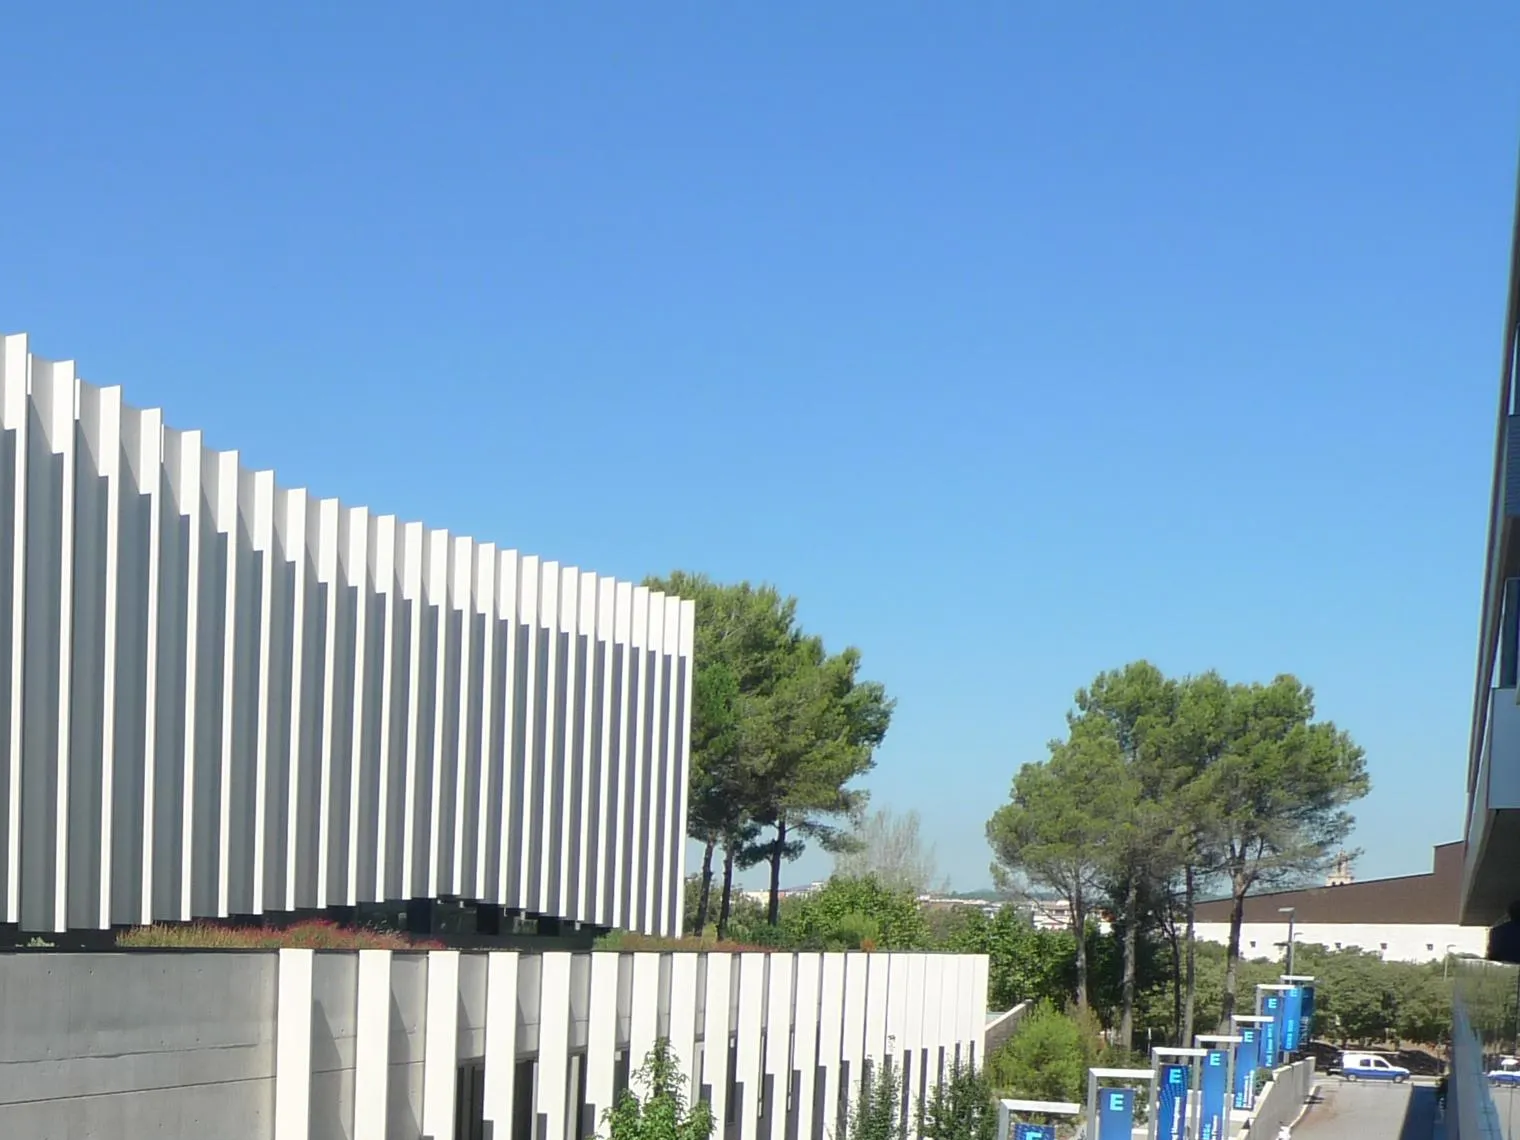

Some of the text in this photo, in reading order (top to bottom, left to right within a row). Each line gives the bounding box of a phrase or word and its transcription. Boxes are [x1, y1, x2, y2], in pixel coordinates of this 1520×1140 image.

[1268, 998, 1277, 1008] E
[1243, 1031, 1253, 1043] E
[1209, 1053, 1221, 1066] E
[1168, 1068, 1181, 1084] E
[1109, 1093, 1124, 1111] E
